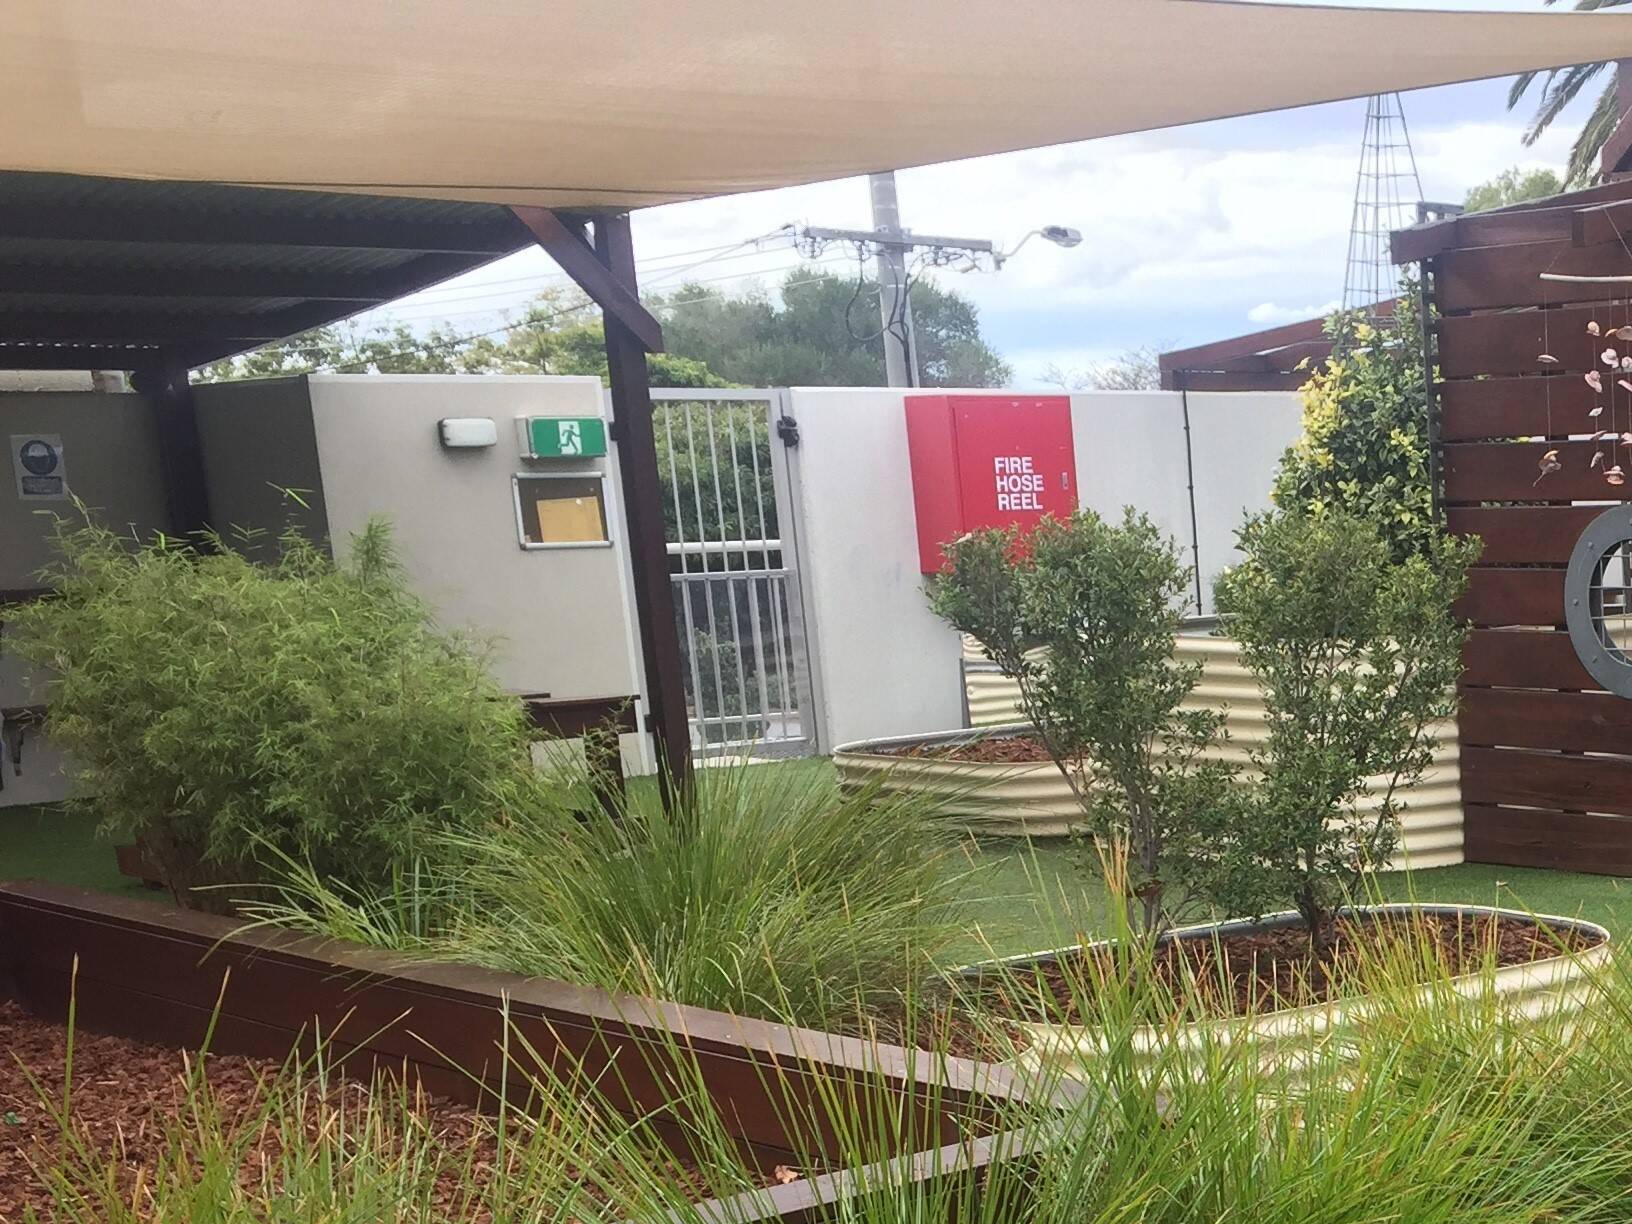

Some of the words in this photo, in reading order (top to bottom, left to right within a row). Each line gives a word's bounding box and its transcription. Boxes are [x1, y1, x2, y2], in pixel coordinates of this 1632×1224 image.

[994, 457, 1033, 474] FIRE
[996, 475, 1044, 492] HOSE
[998, 493, 1043, 510] REEL
